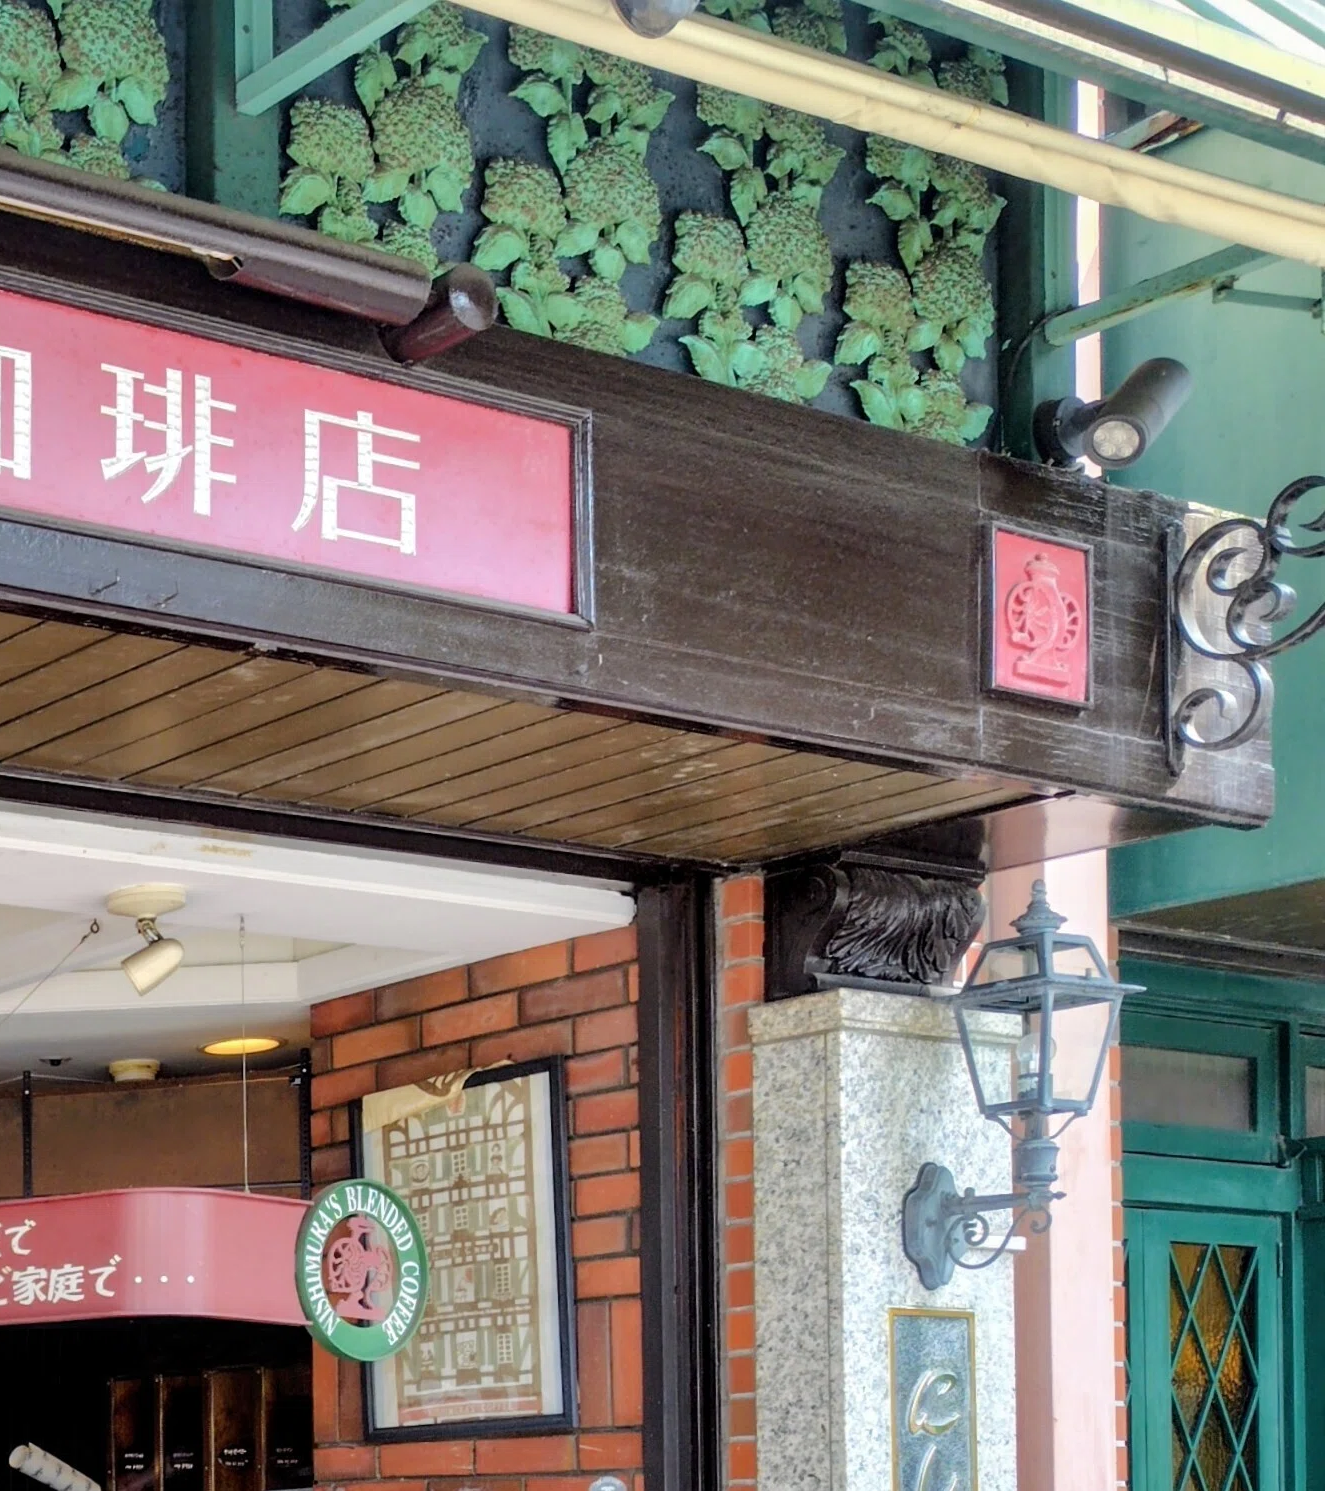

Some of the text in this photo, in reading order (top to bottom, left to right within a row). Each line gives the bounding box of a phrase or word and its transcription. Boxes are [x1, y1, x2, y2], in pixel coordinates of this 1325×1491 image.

[305, 1185, 420, 1345] NISHIMURA'S BLENDED COFFEE
